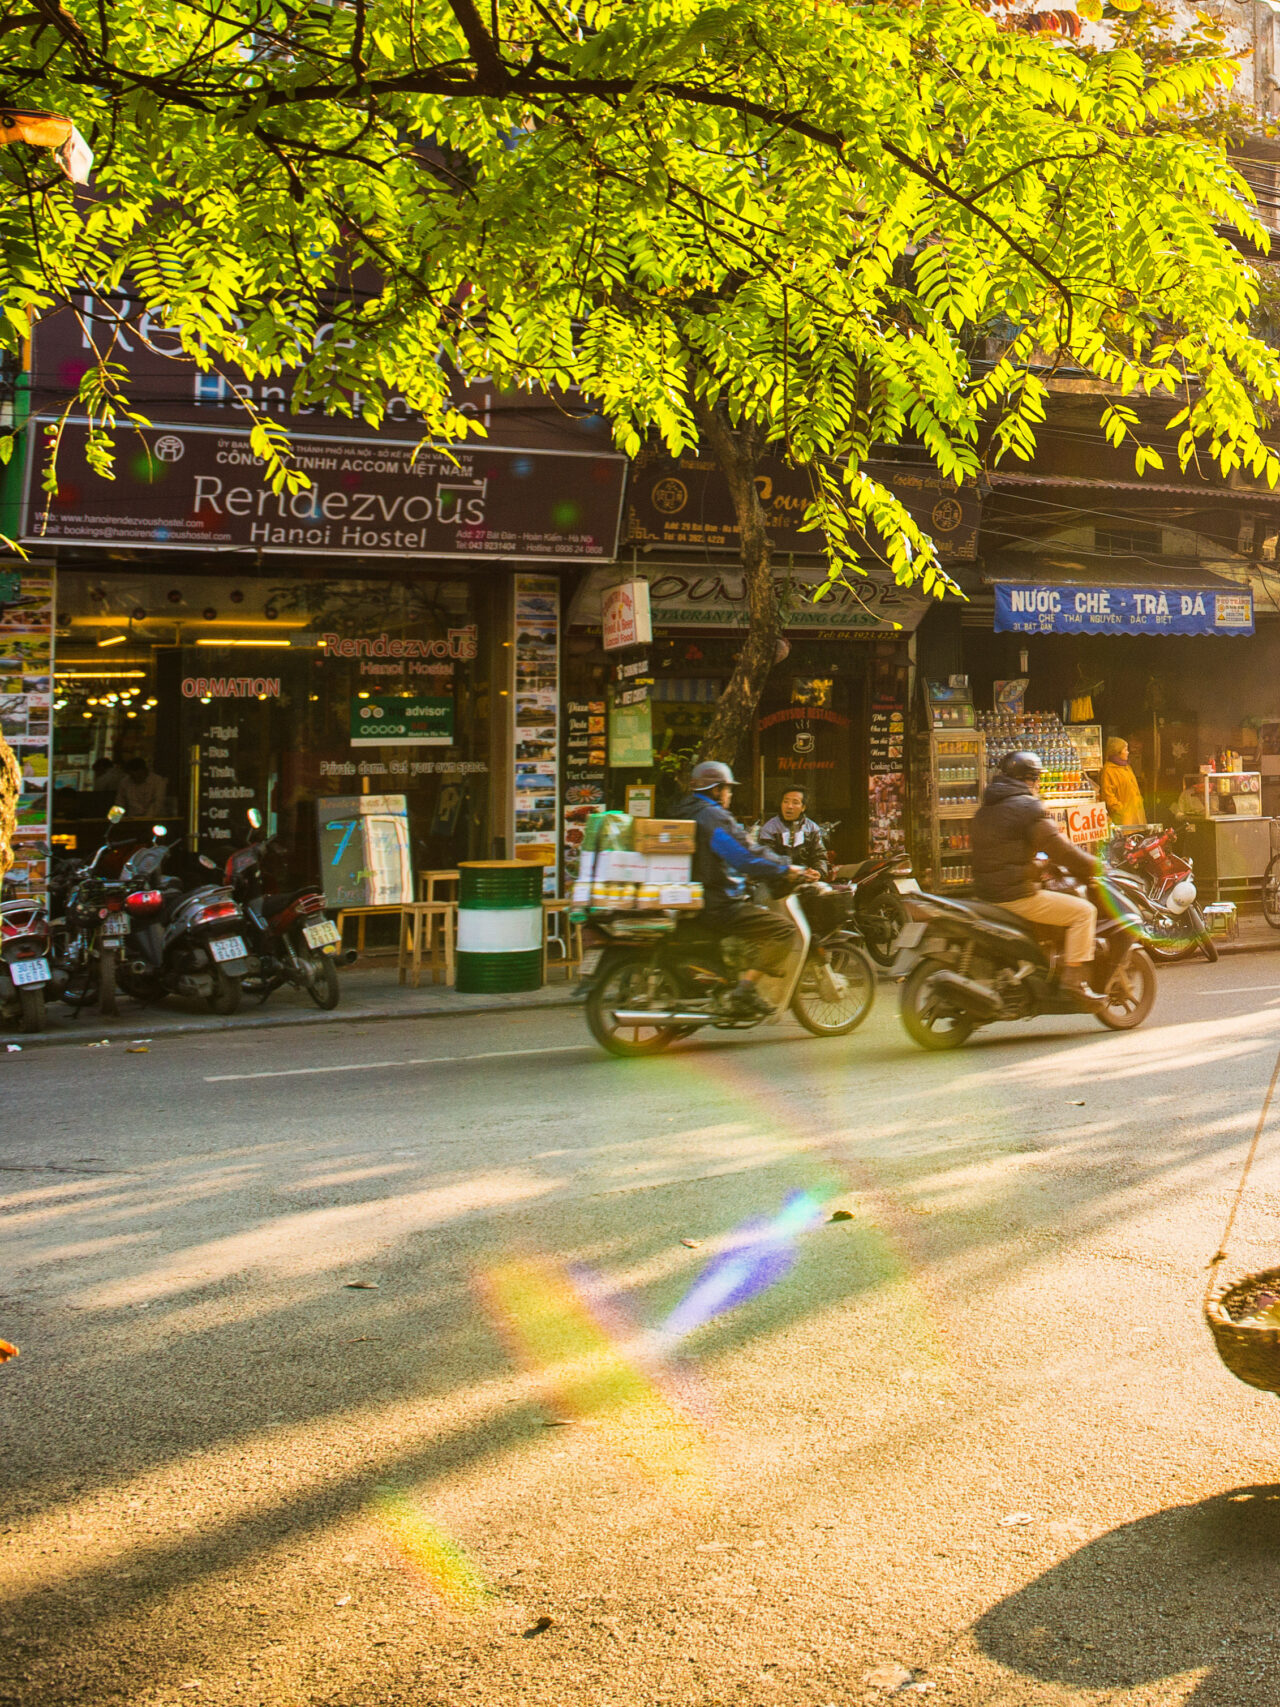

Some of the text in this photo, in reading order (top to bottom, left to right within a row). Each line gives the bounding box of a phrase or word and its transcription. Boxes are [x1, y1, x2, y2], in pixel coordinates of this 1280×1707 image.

[216, 449, 265, 466] CÔNG
[294, 456, 337, 470] TNHH
[340, 460, 399, 474] ACCOM
[193, 476, 486, 526] Rendezvous
[34, 511, 59, 523] Wb:
[250, 521, 427, 548] Hanoi Hostel
[1011, 586, 1061, 614] NƯỚC
[1074, 588, 1111, 614] CHÈ
[1133, 589, 1170, 616] TRÀ
[1180, 590, 1207, 616] ĐÁ
[323, 625, 479, 659] Rendezvous
[208, 807, 230, 819] Car
[1069, 807, 1106, 832] Café
